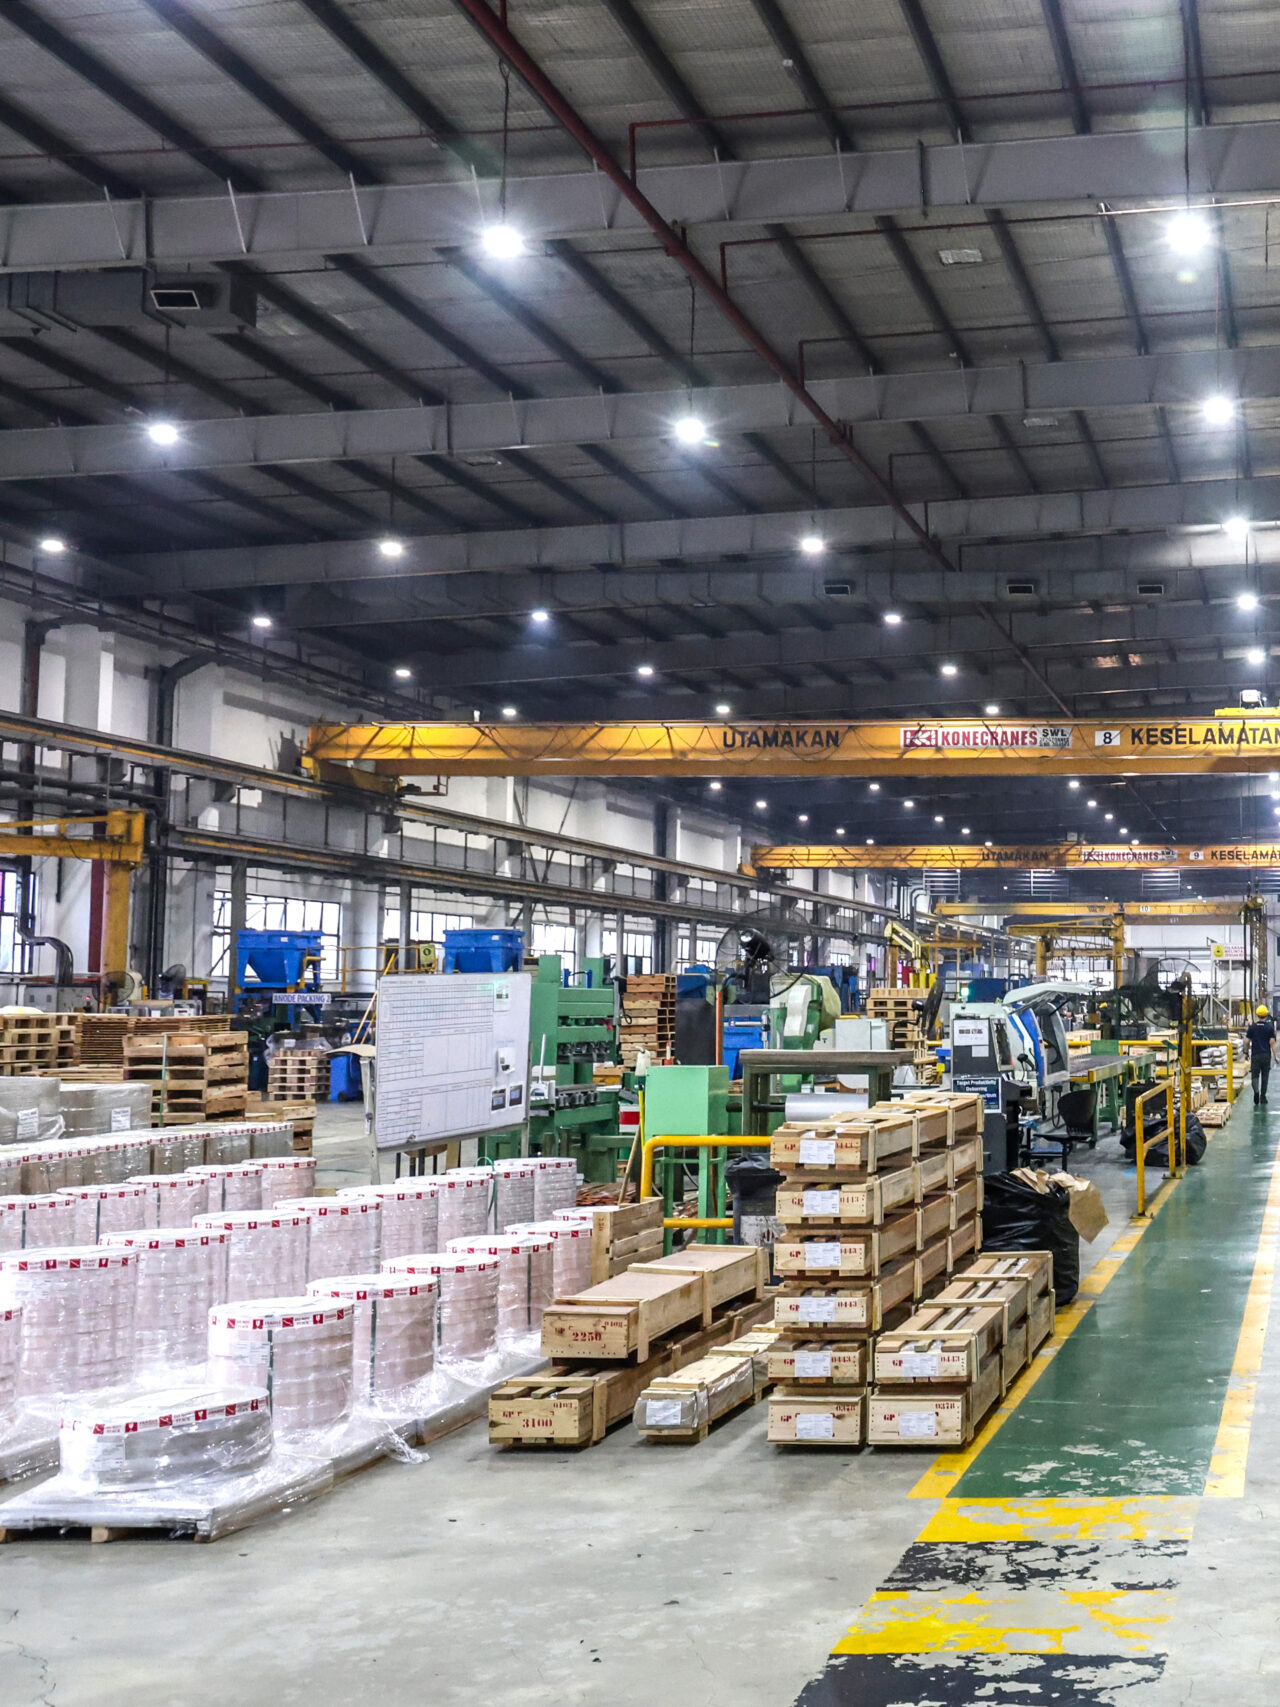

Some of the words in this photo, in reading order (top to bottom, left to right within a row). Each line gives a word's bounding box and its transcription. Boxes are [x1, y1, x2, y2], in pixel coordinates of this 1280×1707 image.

[941, 731, 1038, 746] KONECRANES
[1042, 728, 1067, 737] SWL
[1103, 732, 1112, 744] 8
[723, 730, 840, 748] UTAMAKAN
[1194, 852, 1200, 860] 9
